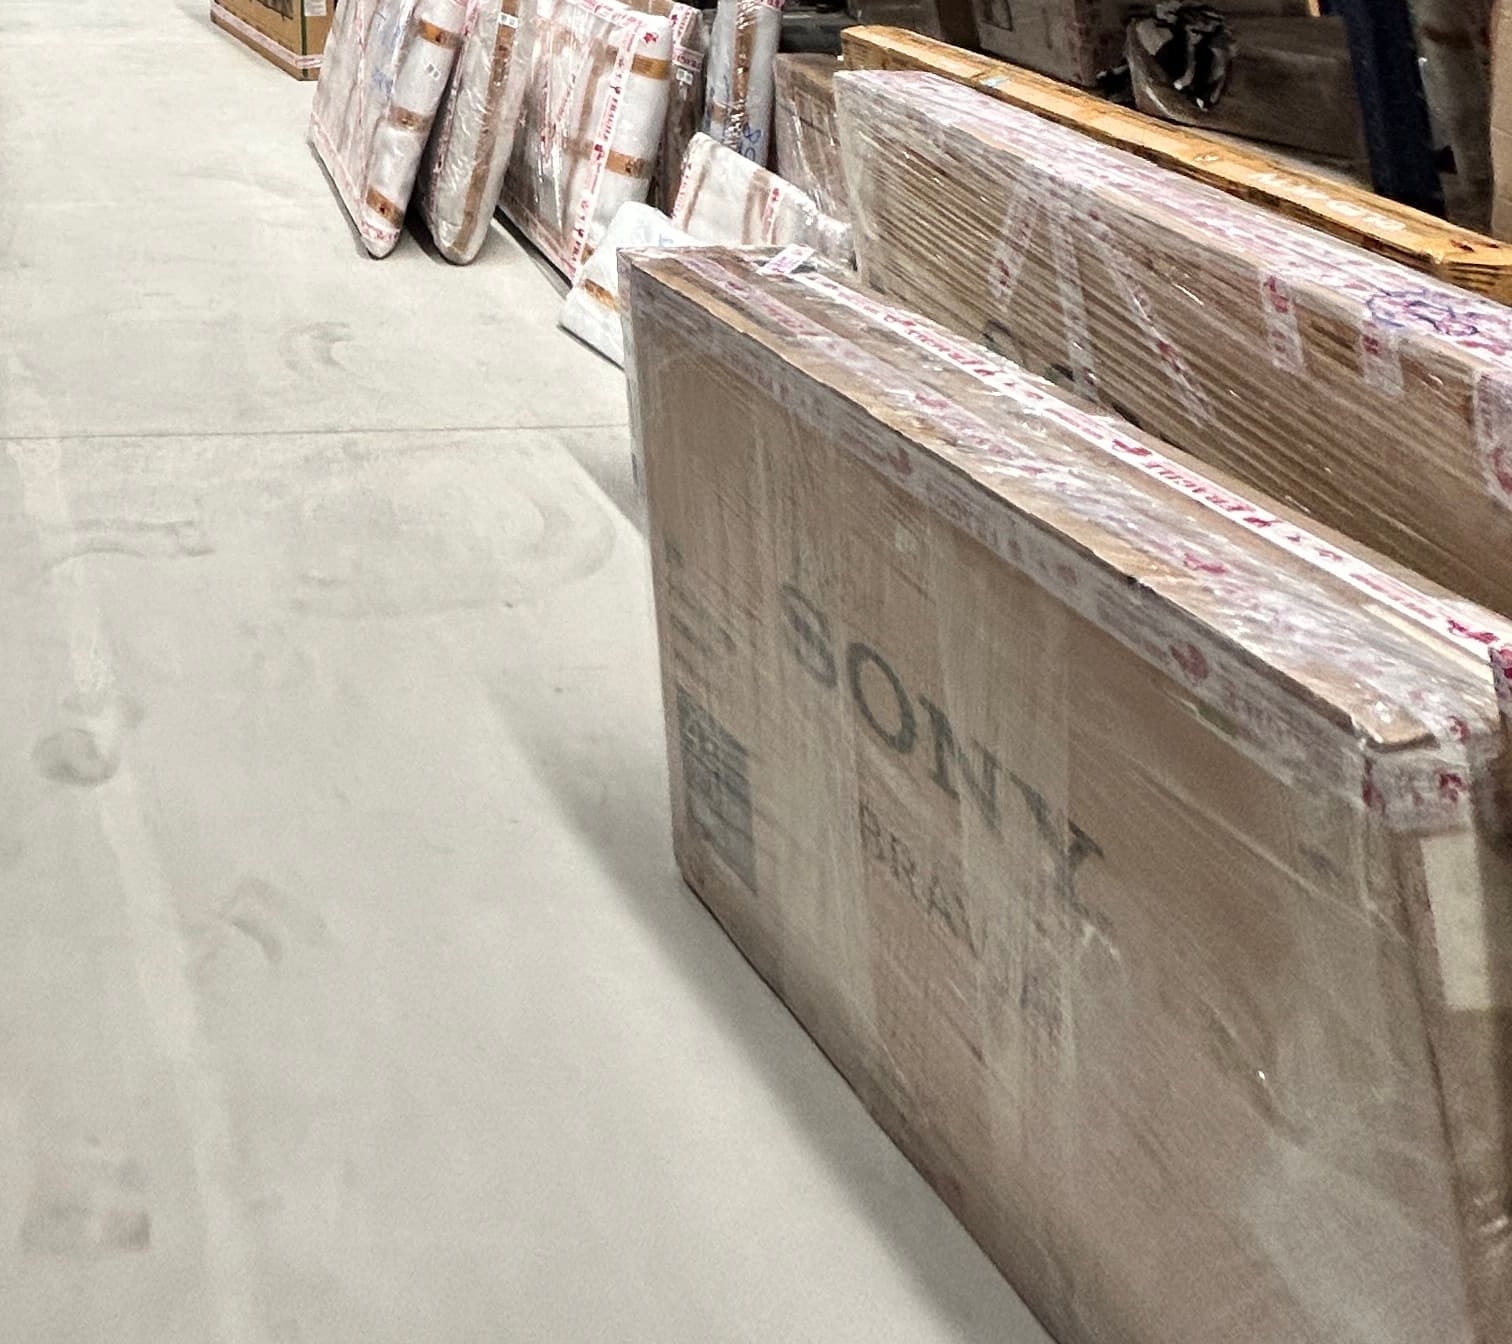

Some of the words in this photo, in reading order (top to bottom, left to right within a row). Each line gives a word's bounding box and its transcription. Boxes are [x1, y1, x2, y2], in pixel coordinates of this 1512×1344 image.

[603, 97, 619, 141] FRAGILE
[1146, 459, 1258, 514] FRAGILE
[778, 582, 1115, 930] SONY
